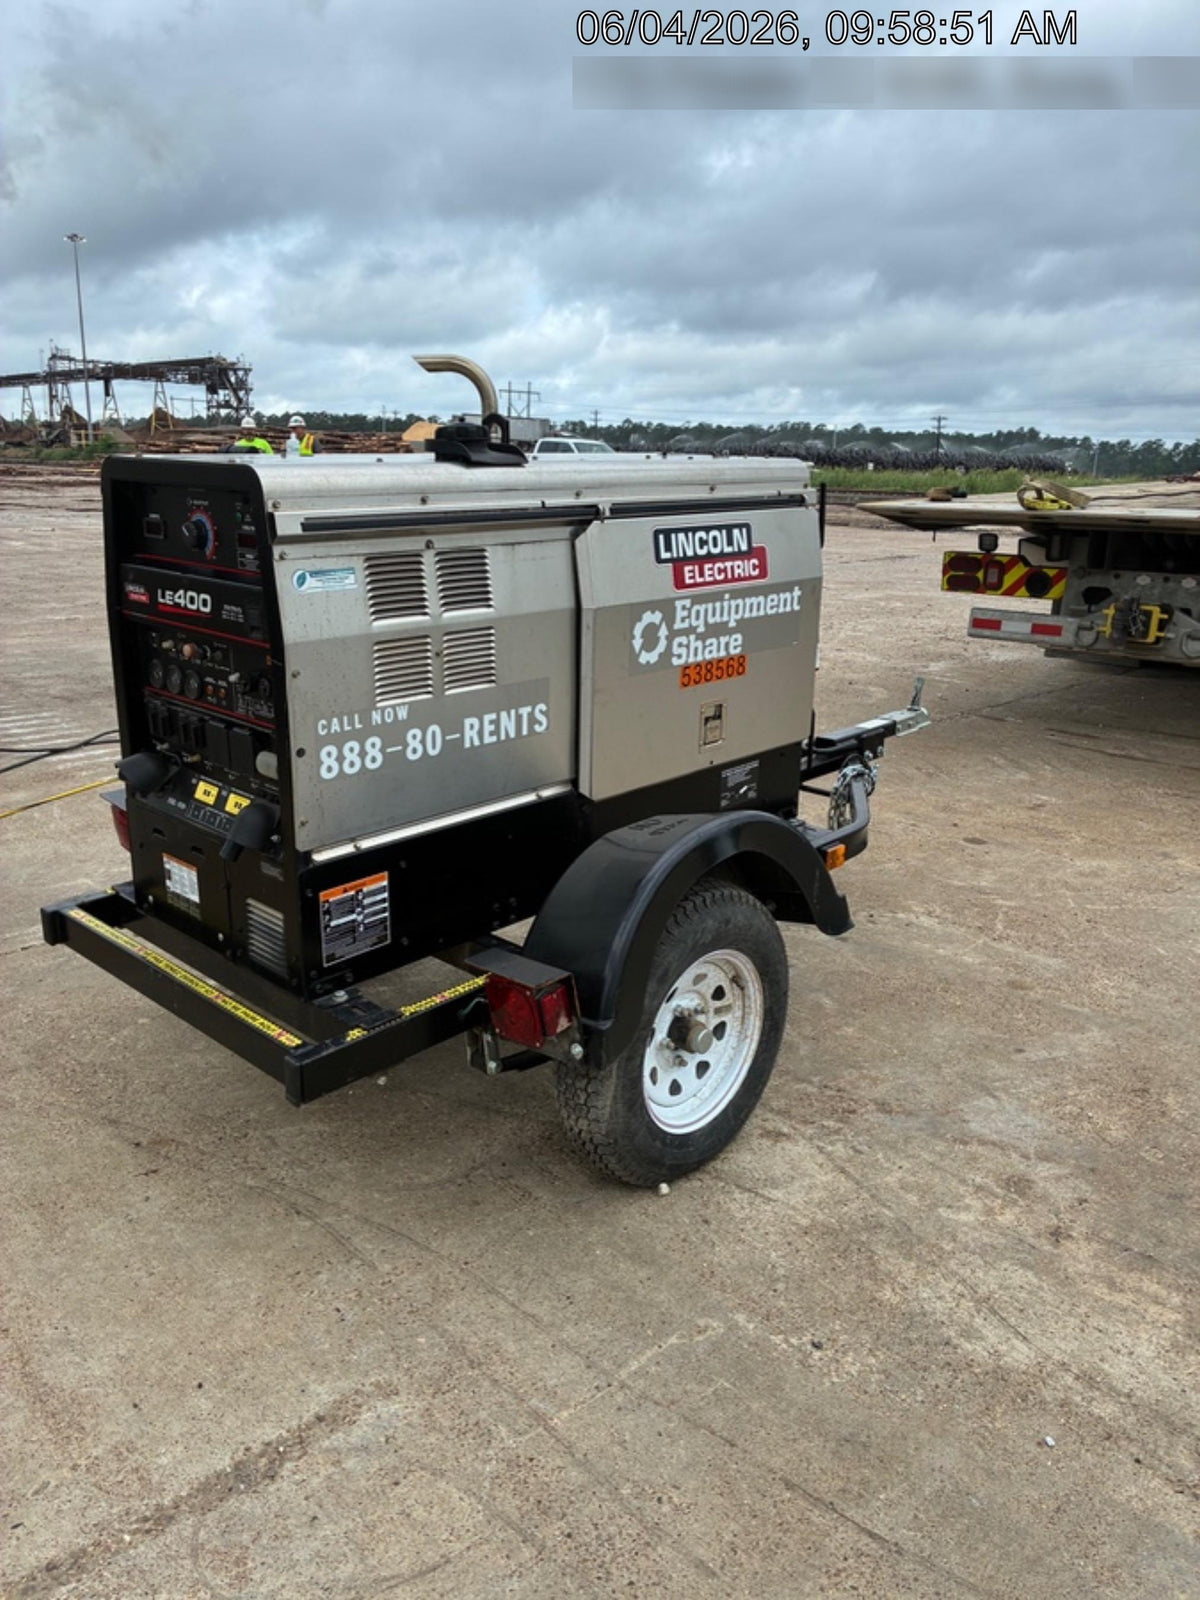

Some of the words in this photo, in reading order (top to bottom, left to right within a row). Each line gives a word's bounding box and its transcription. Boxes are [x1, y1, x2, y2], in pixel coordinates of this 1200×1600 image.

[658, 527, 748, 559] LINCOLN
[683, 558, 760, 584] ELECTRIC
[157, 588, 212, 613] LE400
[673, 586, 802, 633] Equipment
[671, 632, 743, 666] Share
[680, 655, 746, 688] 538568
[317, 713, 363, 735] CALL
[371, 705, 409, 725] NOW
[318, 703, 549, 780] 888-80-RENTS
